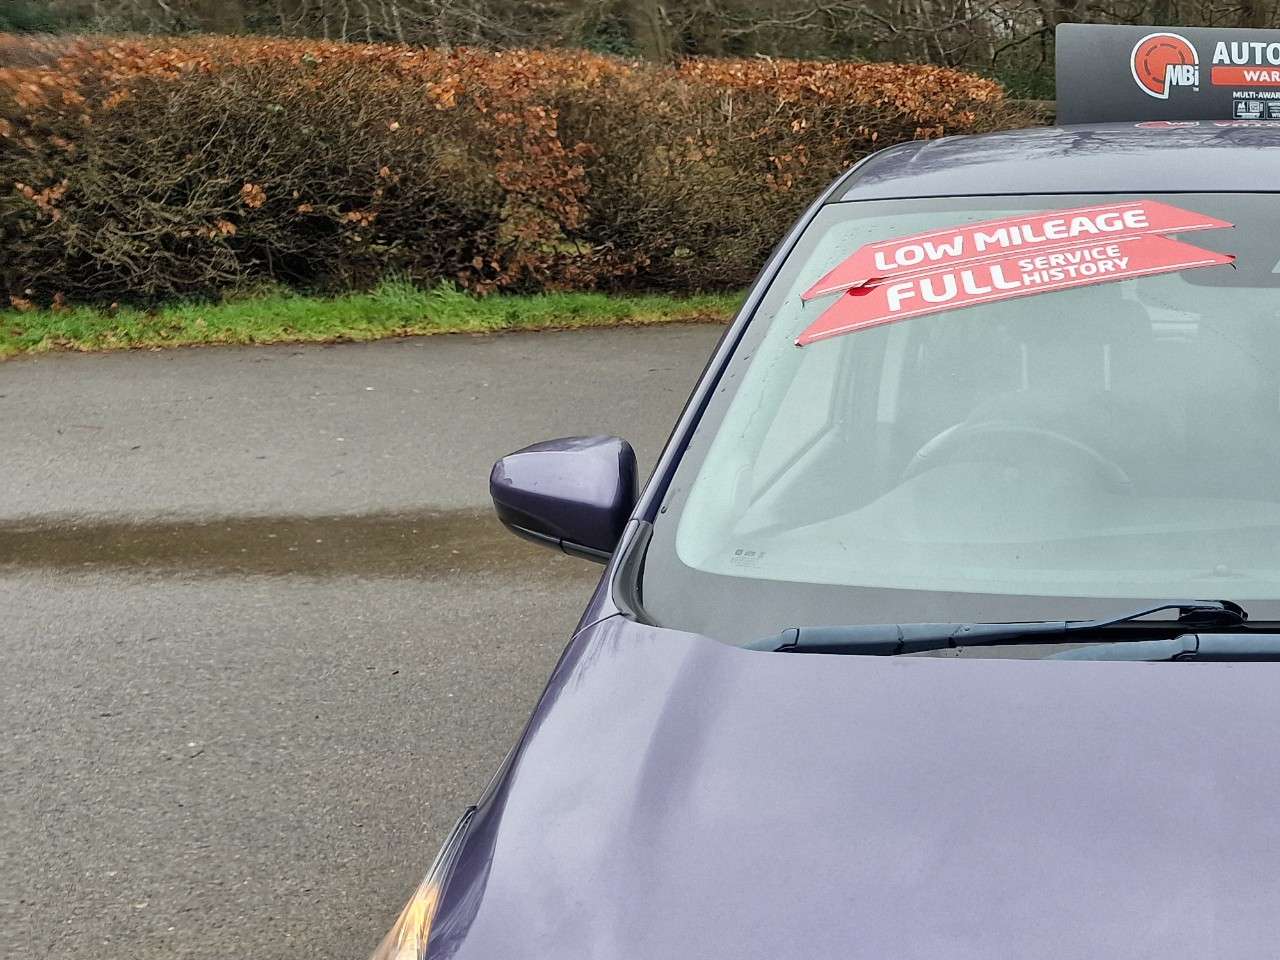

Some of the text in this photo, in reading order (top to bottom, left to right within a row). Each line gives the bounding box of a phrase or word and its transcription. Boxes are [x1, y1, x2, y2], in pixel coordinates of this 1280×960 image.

[1166, 64, 1199, 86] MBi
[874, 209, 1149, 271] LOW MILEAGE
[1020, 245, 1120, 272] SERVICE
[1022, 256, 1130, 286] HISTORY
[885, 263, 1021, 312] FULL
